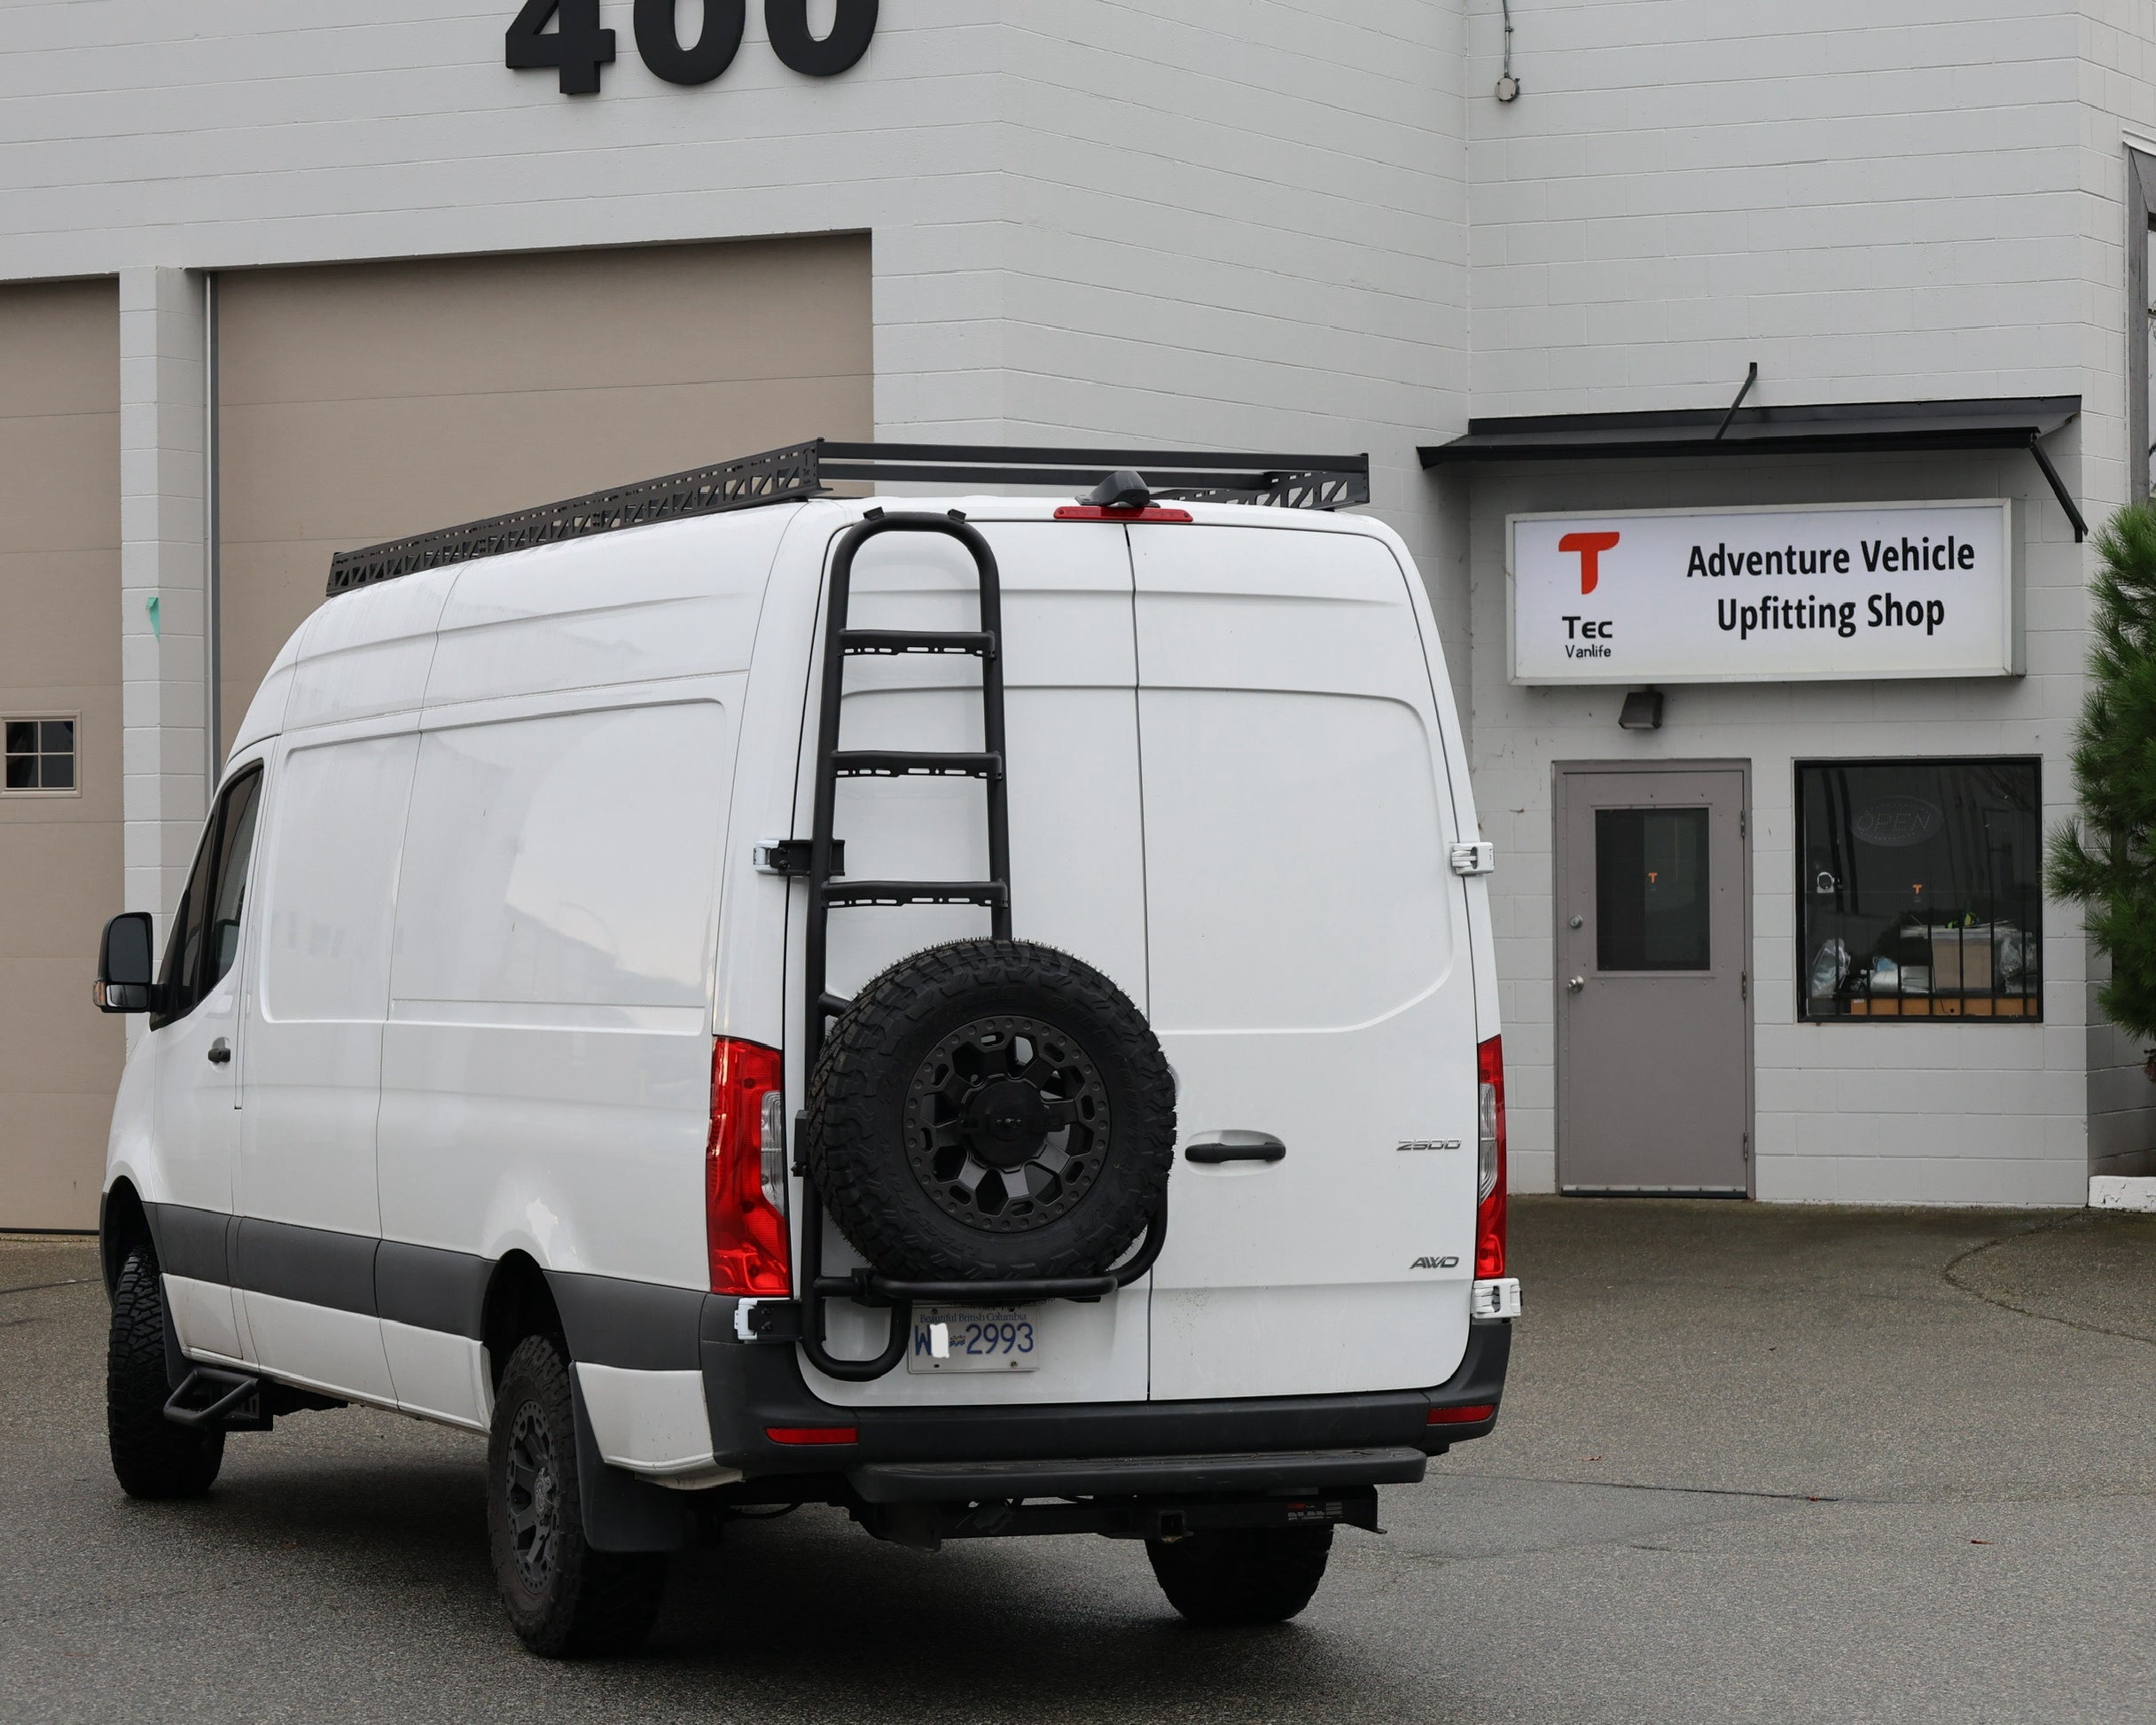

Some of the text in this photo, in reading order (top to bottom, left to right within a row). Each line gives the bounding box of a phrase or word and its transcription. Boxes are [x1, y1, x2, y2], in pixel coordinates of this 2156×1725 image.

[1686, 535, 1975, 578] Adventure Vehicle
[1717, 592, 1945, 640] Upfitting Shop
[1565, 644, 1612, 659] Vanlife
[1857, 811, 1931, 832] OPEN
[1396, 1138, 1461, 1151] 2500
[1409, 1256, 1460, 1269] AWD
[920, 1311, 1027, 1323] Beautiful British Columbia
[965, 1322, 1034, 1354] 2993
